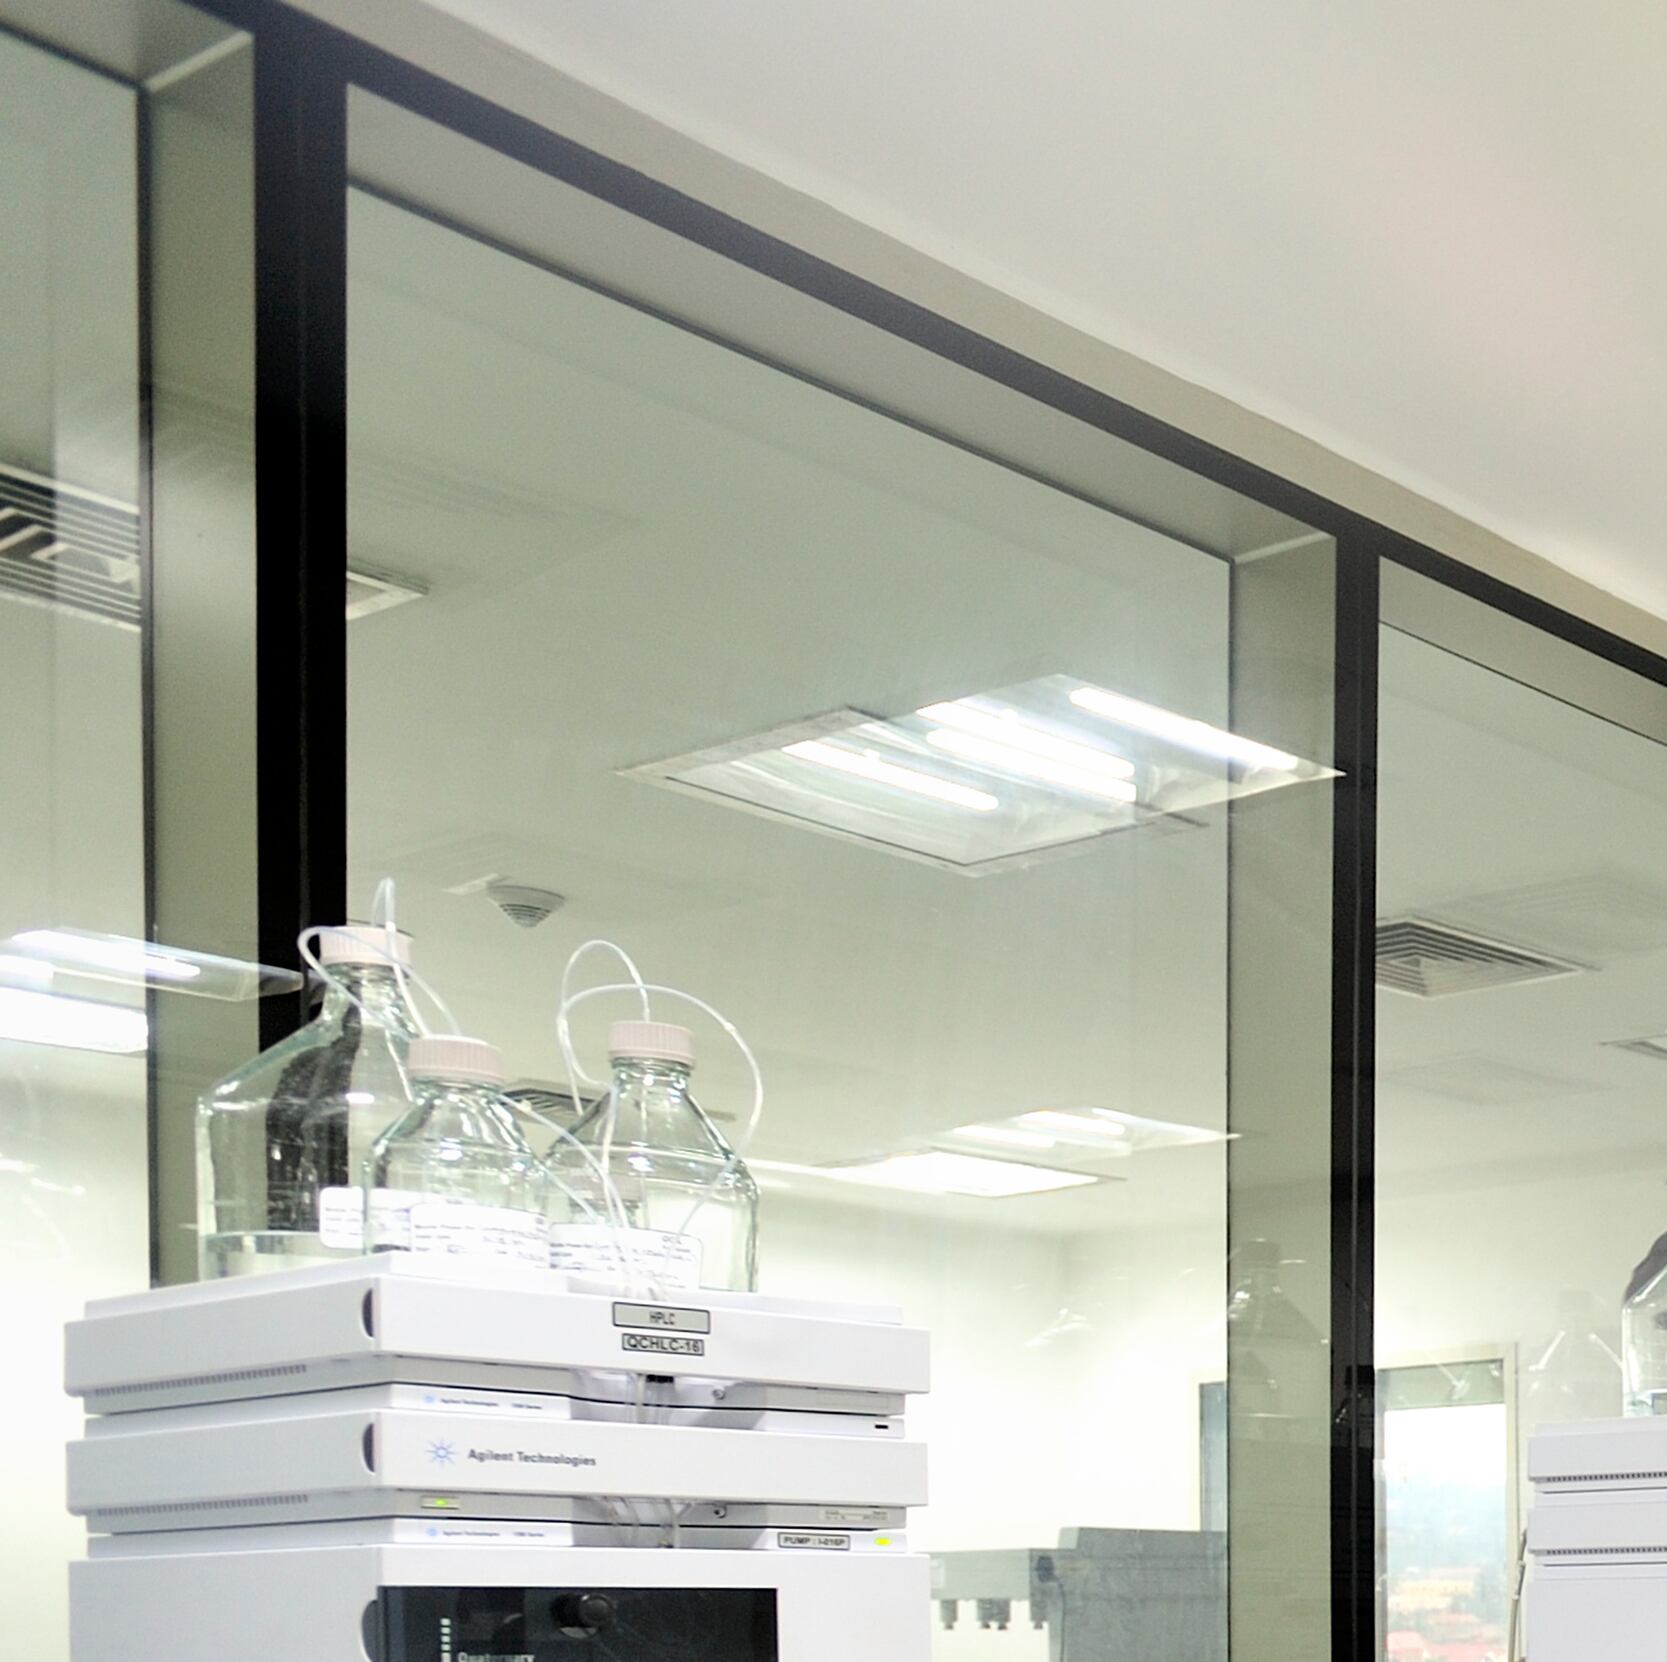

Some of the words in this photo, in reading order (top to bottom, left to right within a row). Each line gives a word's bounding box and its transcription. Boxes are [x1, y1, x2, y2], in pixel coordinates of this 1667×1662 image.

[648, 1310, 676, 1326] HPLC
[627, 1336, 701, 1354] QCHLC-16
[468, 1448, 514, 1464] Agilent
[516, 1450, 597, 1468] Technologies
